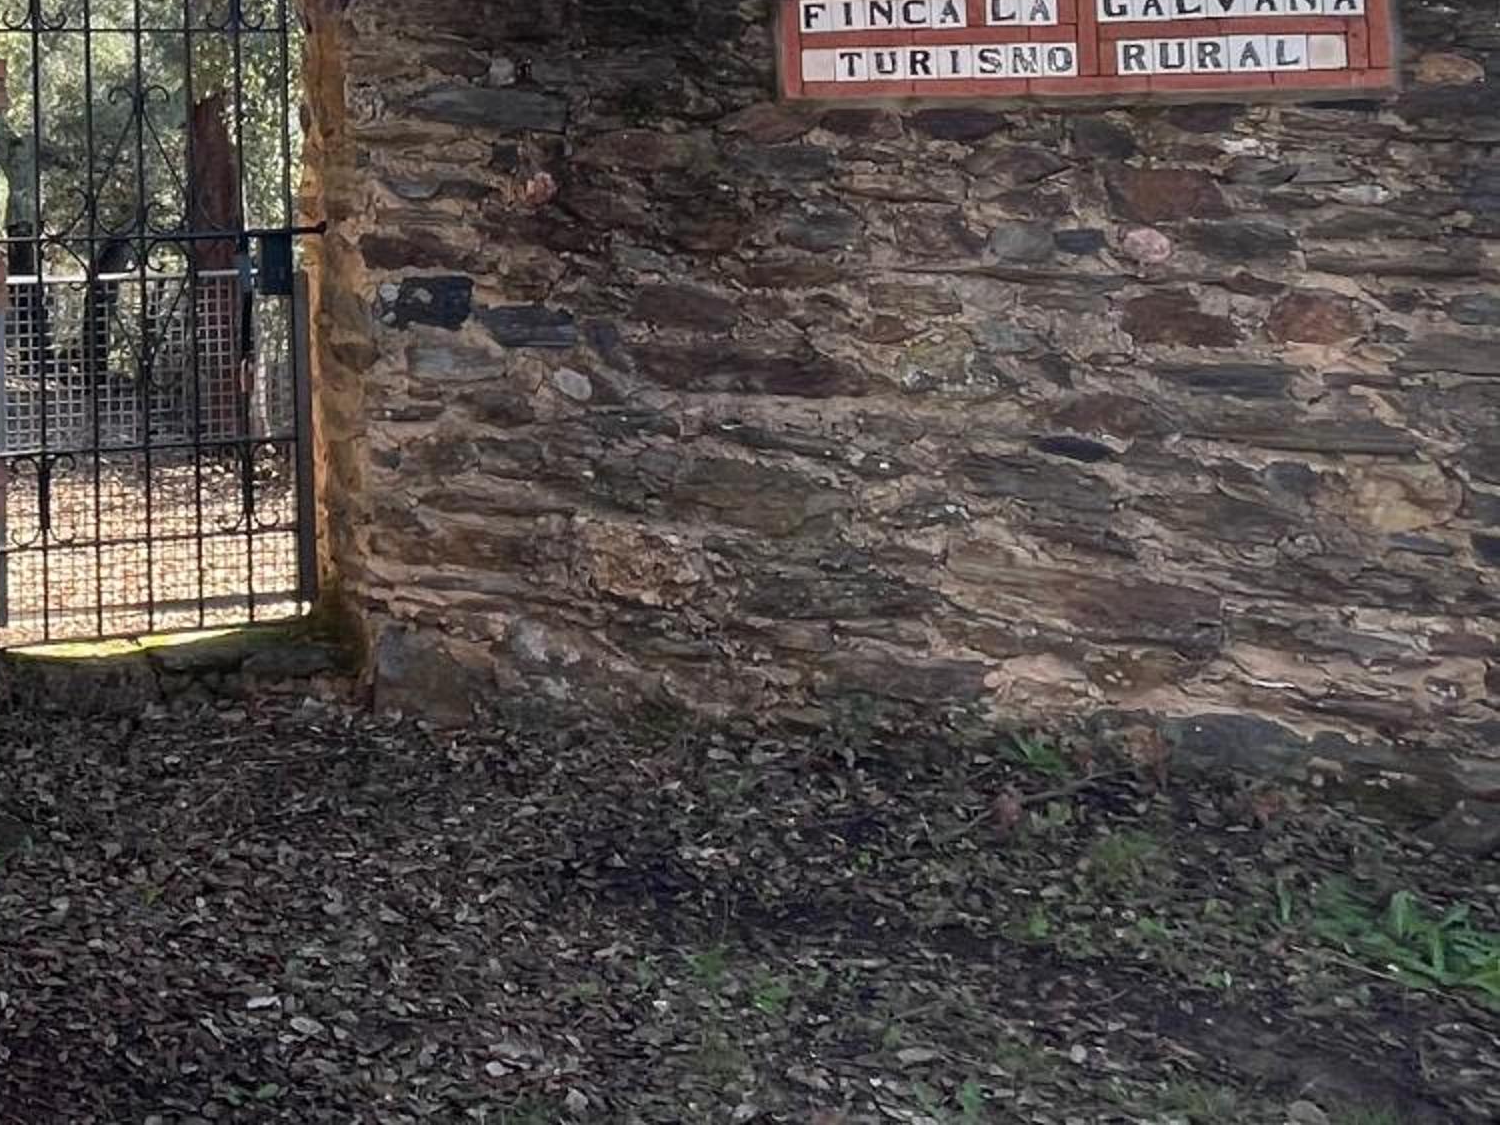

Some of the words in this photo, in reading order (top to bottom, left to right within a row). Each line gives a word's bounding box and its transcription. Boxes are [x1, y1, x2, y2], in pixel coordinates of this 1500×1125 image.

[803, 0, 961, 28] FINCA
[839, 47, 1073, 77] TURISMO
[1122, 39, 1301, 71] RURAL
